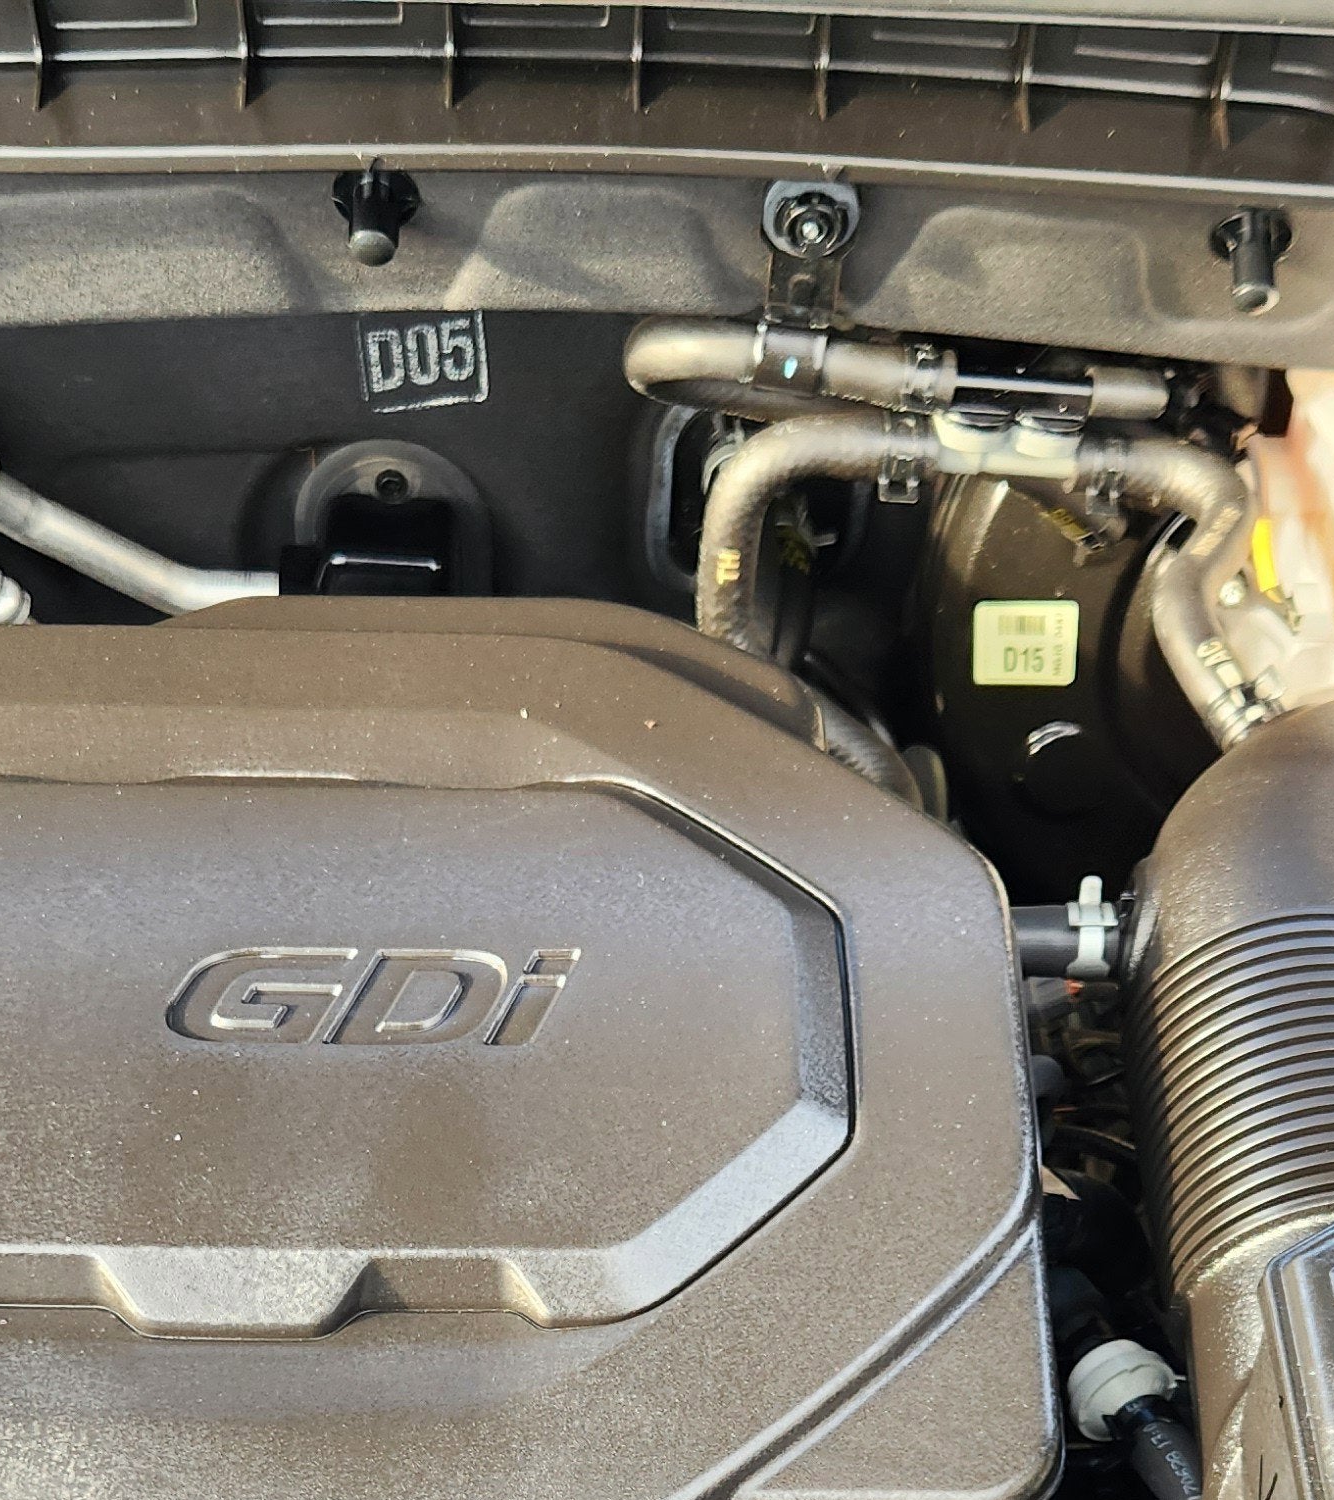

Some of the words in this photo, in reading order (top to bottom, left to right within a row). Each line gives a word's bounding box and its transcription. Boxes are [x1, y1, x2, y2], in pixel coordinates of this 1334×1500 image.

[367, 318, 475, 393] D05
[1003, 646, 1046, 674] D15
[165, 946, 582, 1047] GDi
